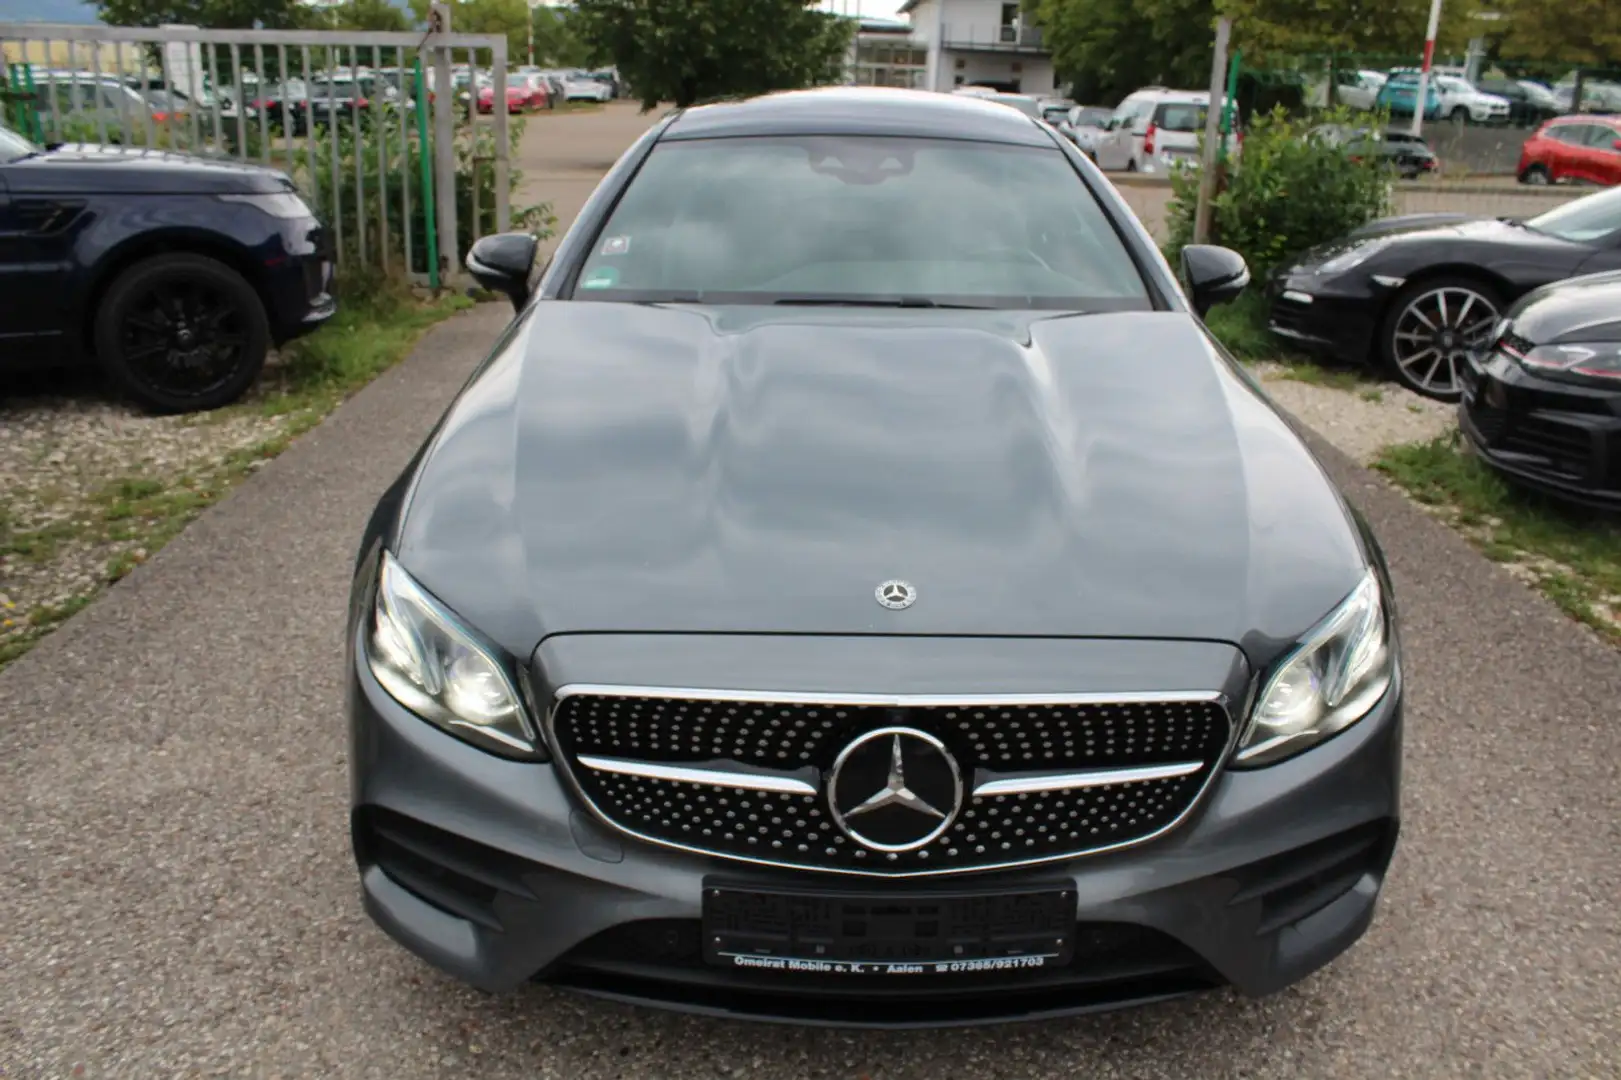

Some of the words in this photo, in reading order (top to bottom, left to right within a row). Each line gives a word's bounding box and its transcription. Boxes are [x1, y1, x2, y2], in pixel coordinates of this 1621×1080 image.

[789, 960, 832, 972] Mobile
[851, 963, 866, 973] K.
[887, 963, 924, 974] Aalen
